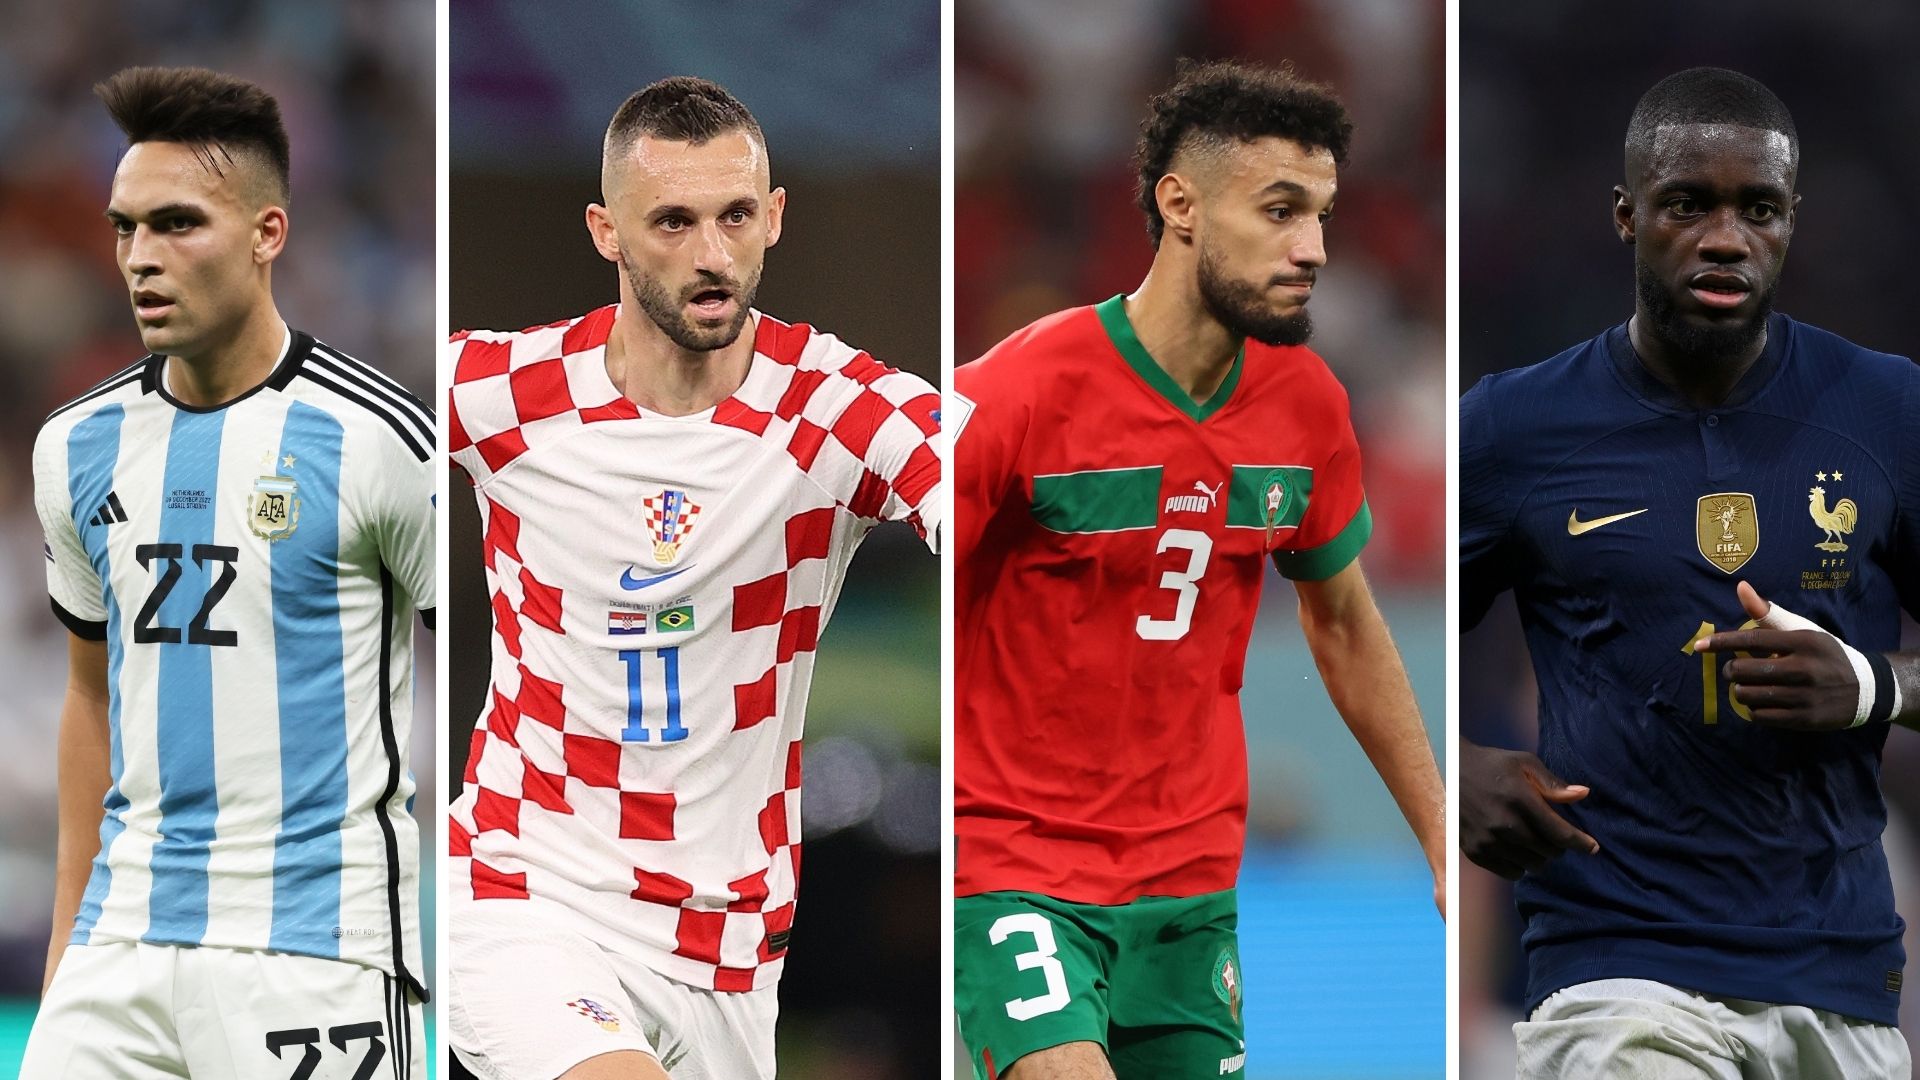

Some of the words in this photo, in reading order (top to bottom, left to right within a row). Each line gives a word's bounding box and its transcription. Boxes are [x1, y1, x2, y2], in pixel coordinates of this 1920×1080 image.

[257, 493, 286, 524] AFA
[1165, 496, 1209, 513] PUMA
[1716, 543, 1742, 553] FIFA
[134, 543, 239, 647] 22
[1136, 528, 1213, 640] 3
[618, 646, 689, 742] 11
[988, 912, 1071, 1021] 3
